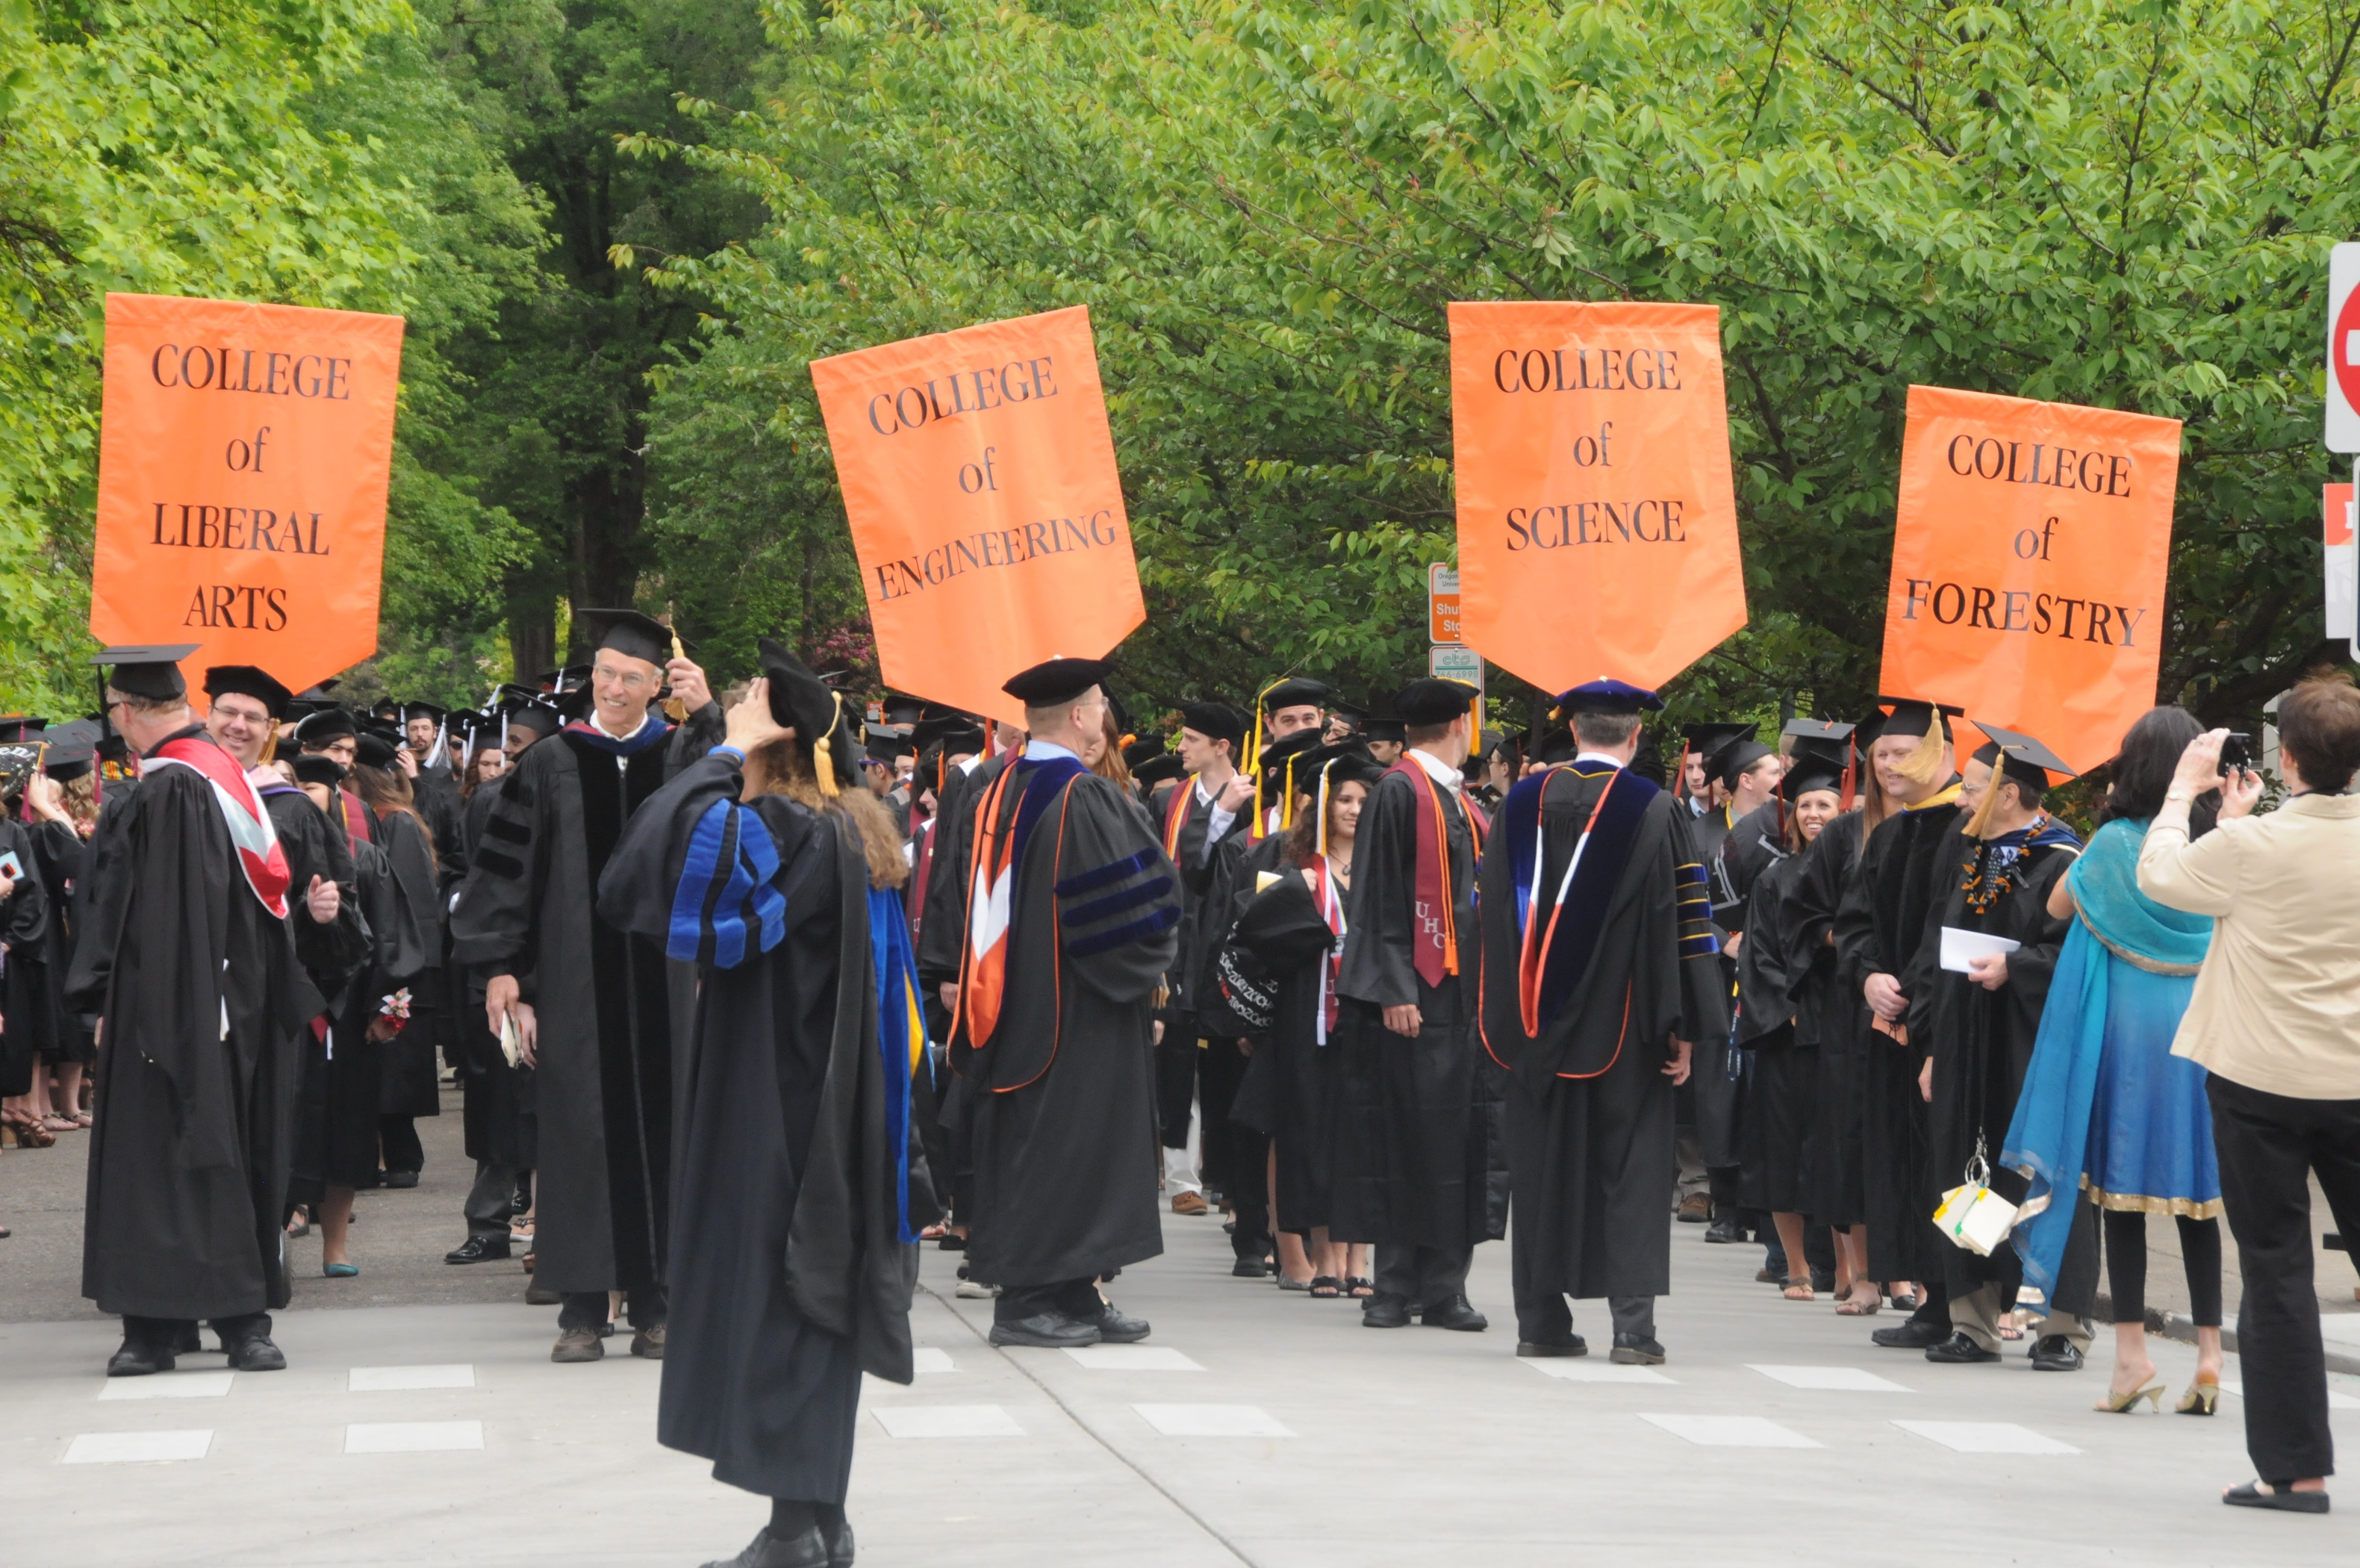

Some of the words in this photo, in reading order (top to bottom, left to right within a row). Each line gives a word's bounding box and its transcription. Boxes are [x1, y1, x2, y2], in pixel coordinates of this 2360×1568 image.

[152, 344, 351, 400] COLLEGE
[868, 356, 1058, 435] COLLEGE
[1494, 349, 1681, 393] COLLEGE
[225, 426, 271, 473] of
[1573, 421, 1613, 467] of
[1948, 435, 2132, 498] COLLEGE
[959, 447, 997, 494] of
[151, 503, 329, 556] LIBERAL
[1506, 500, 1686, 551] SCIENCE
[2014, 516, 2059, 561] of
[875, 510, 1115, 601] ENGINEERING
[182, 585, 287, 632] ARTS
[1902, 578, 2146, 647] FORESTRY
